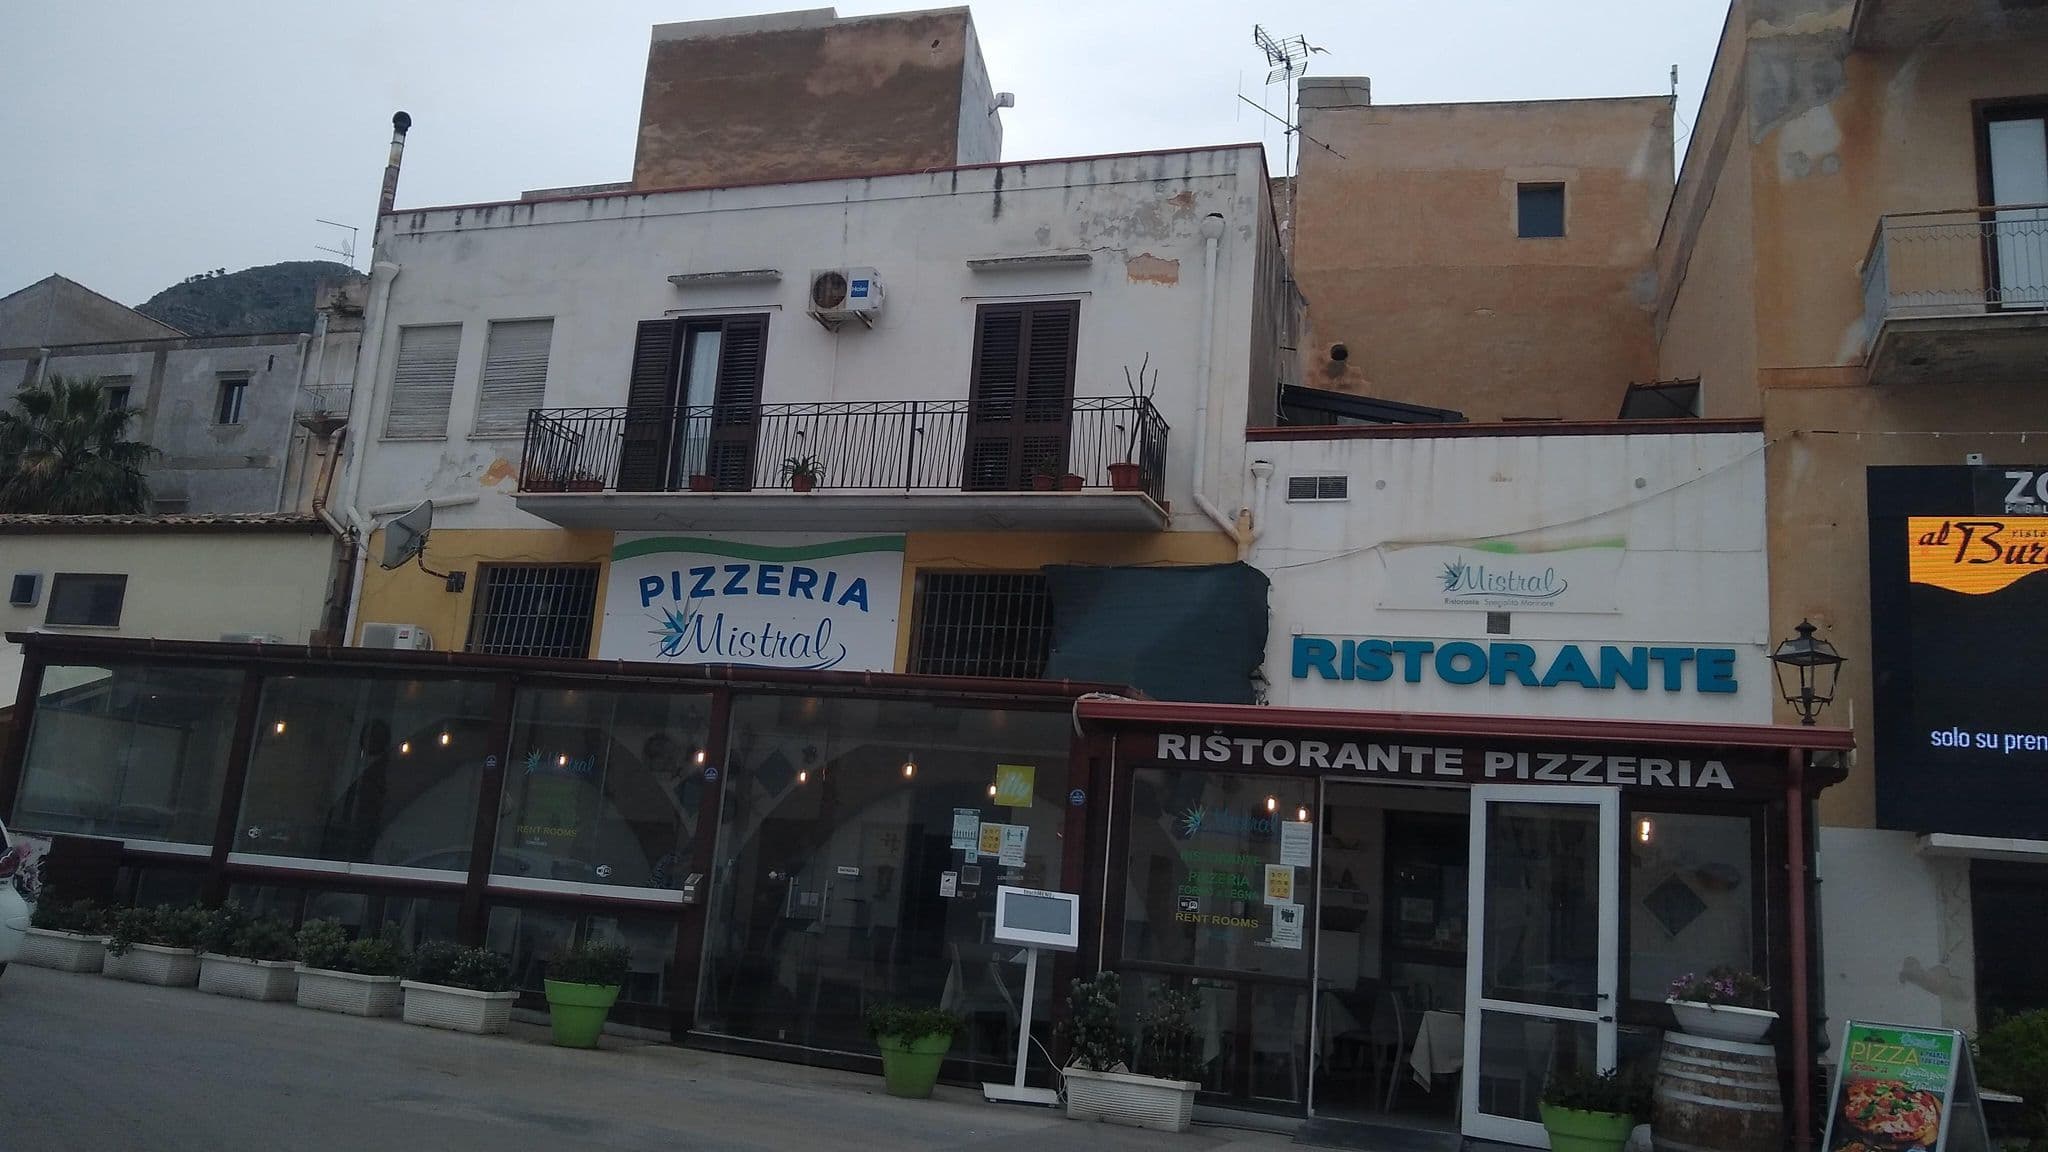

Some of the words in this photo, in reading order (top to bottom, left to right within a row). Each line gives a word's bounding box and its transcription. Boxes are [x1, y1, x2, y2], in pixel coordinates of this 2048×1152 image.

[1918, 520, 1951, 546] al
[639, 563, 870, 613] PIZZERIA
[1446, 565, 1563, 597] Mistral
[657, 612, 844, 666] Mistral
[1291, 636, 1739, 694] RISTORANTE
[1930, 726, 1970, 748] solo
[1975, 732, 1998, 750] su
[1157, 733, 1464, 776] RISTORANTE
[1484, 750, 1735, 790] PIZZERIA
[1175, 912, 1210, 924] RENT
[1212, 915, 1259, 928] ROOMS
[1850, 1041, 1919, 1067] PIZZA
